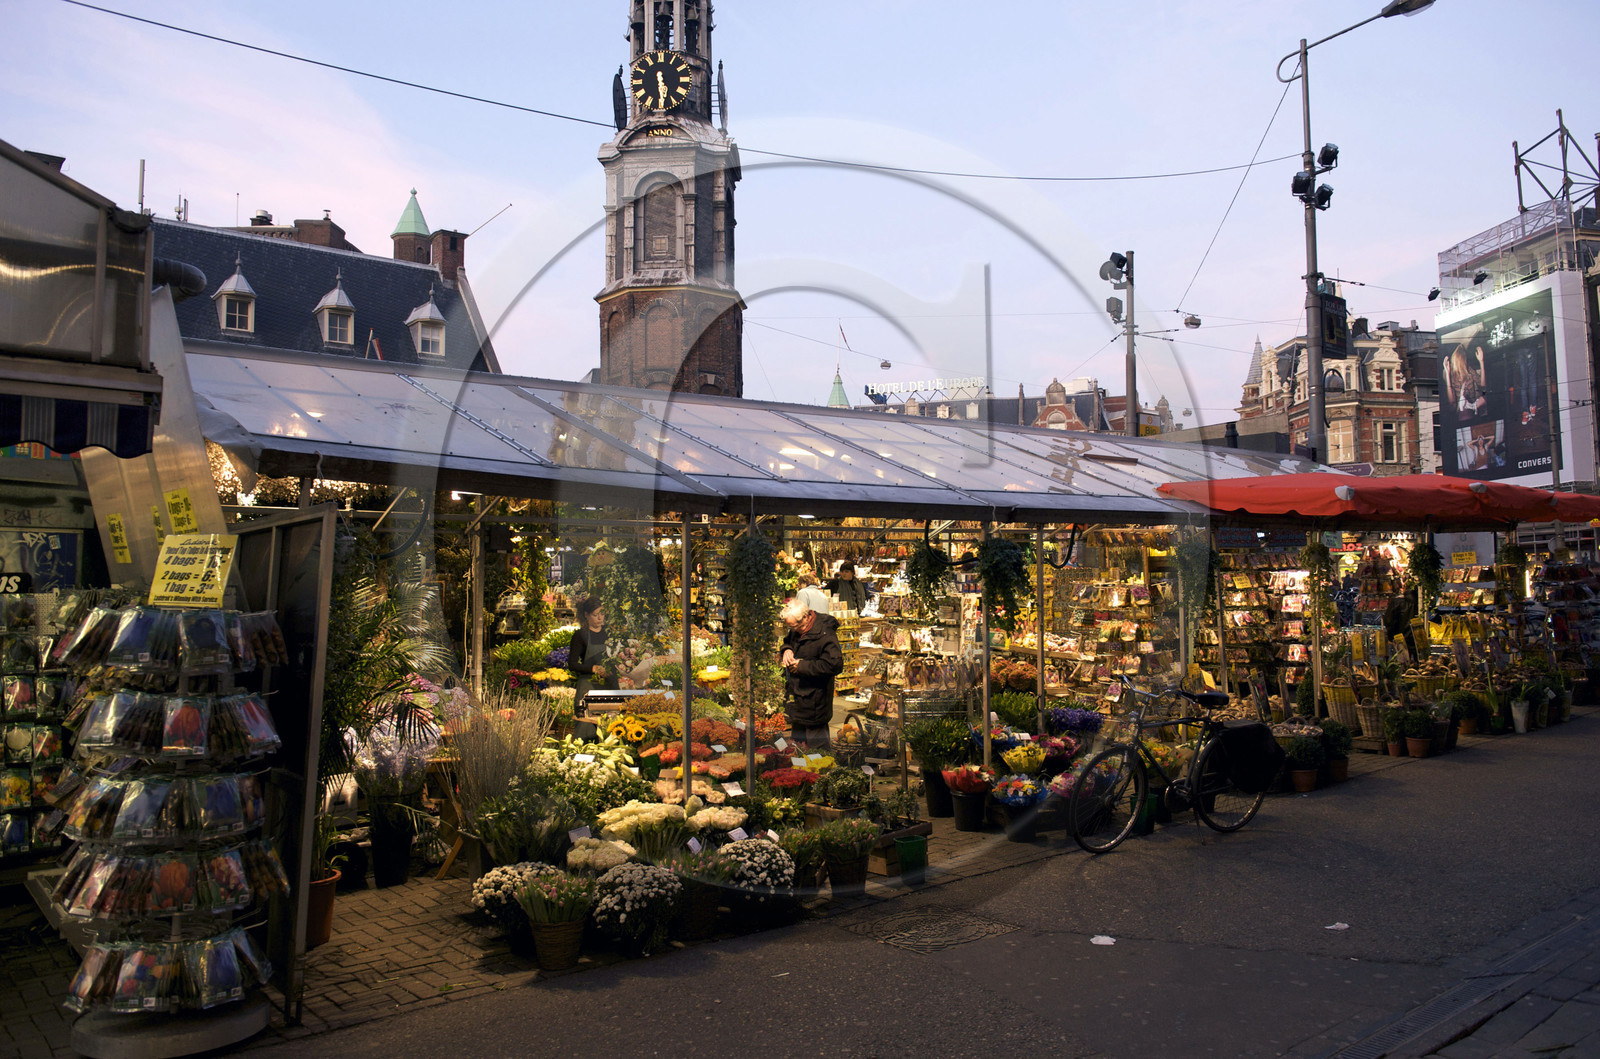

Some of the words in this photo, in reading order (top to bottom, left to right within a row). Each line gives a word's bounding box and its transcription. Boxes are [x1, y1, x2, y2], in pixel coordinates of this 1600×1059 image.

[648, 128, 673, 137] ANNO
[868, 381, 907, 395] HOTEL
[909, 380, 925, 392] DE
[927, 376, 986, 391] L'EUROPE
[1518, 456, 1552, 469] CONVERS
[163, 556, 171, 565] 4
[171, 556, 197, 566] bags
[161, 570, 169, 580] 2
[168, 571, 192, 582] bags
[163, 581, 170, 592] 1
[169, 581, 188, 594] bag
